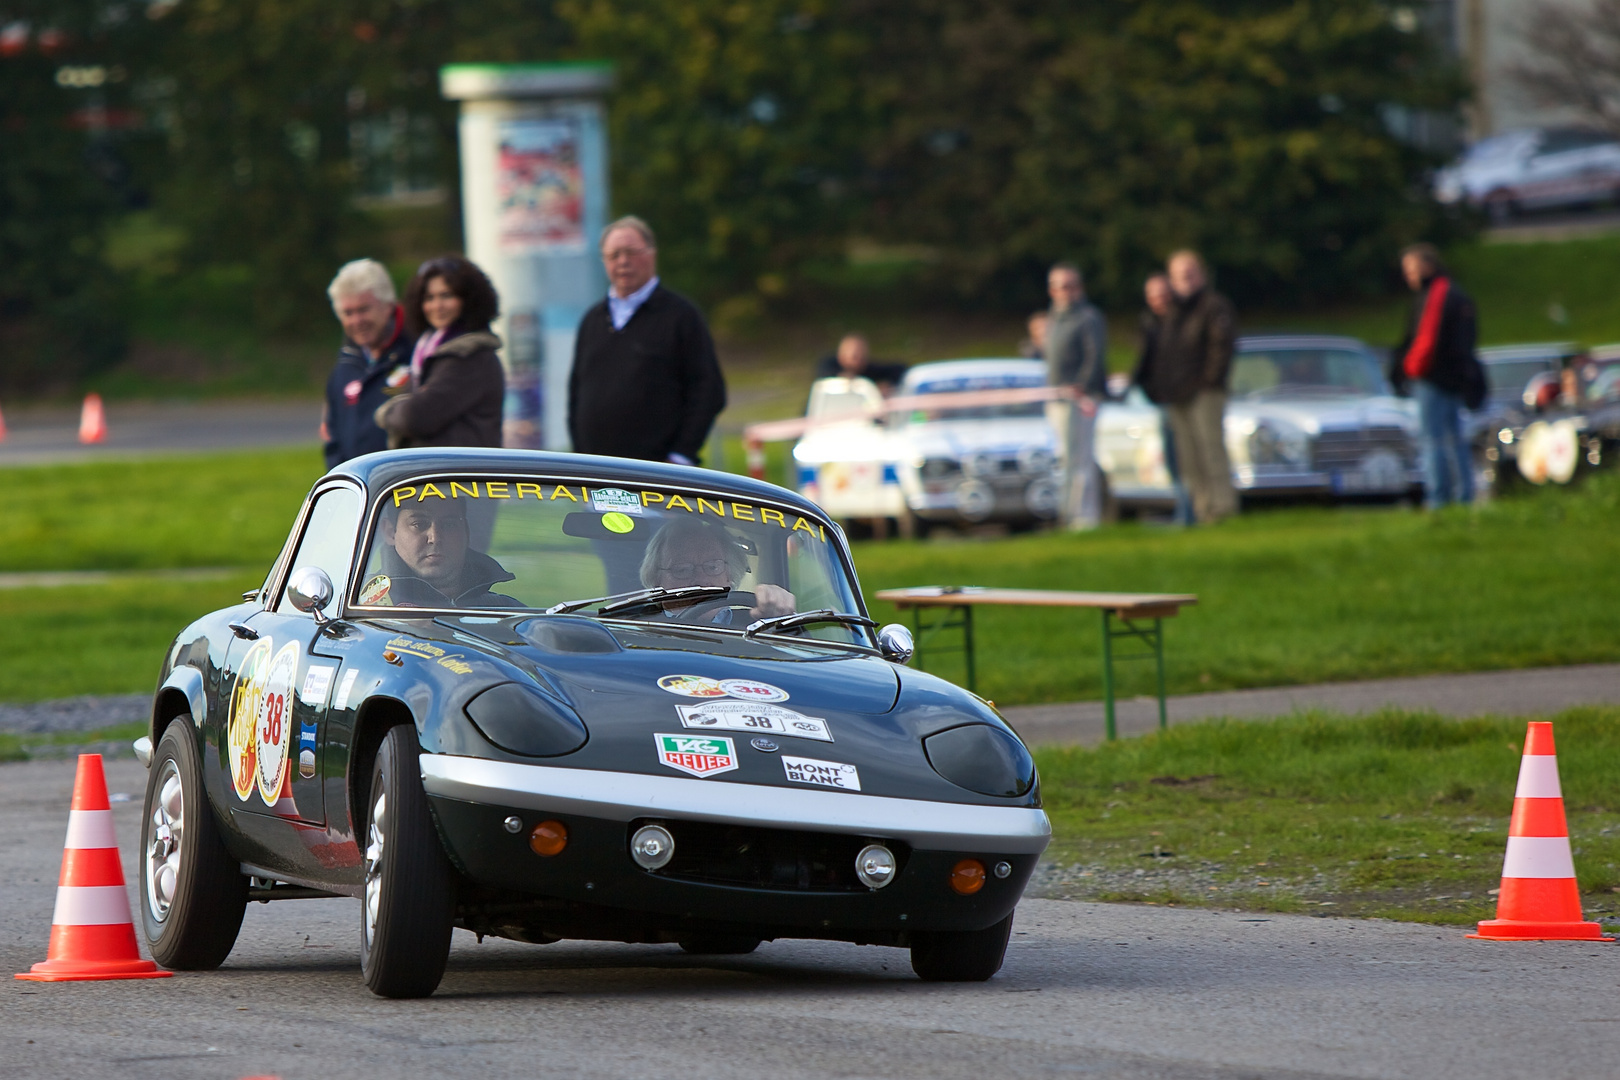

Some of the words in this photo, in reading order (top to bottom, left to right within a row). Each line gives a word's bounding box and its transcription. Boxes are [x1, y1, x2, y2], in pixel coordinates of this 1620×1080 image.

[393, 481, 589, 508] PANERAI
[641, 490, 826, 543] PANERAI
[733, 685, 773, 697] 38
[263, 692, 284, 746] 38
[741, 714, 773, 729] 38
[671, 738, 720, 754] TAG
[667, 752, 731, 772] HEUER
[786, 762, 841, 777] MONT
[789, 771, 844, 787] BLANC
